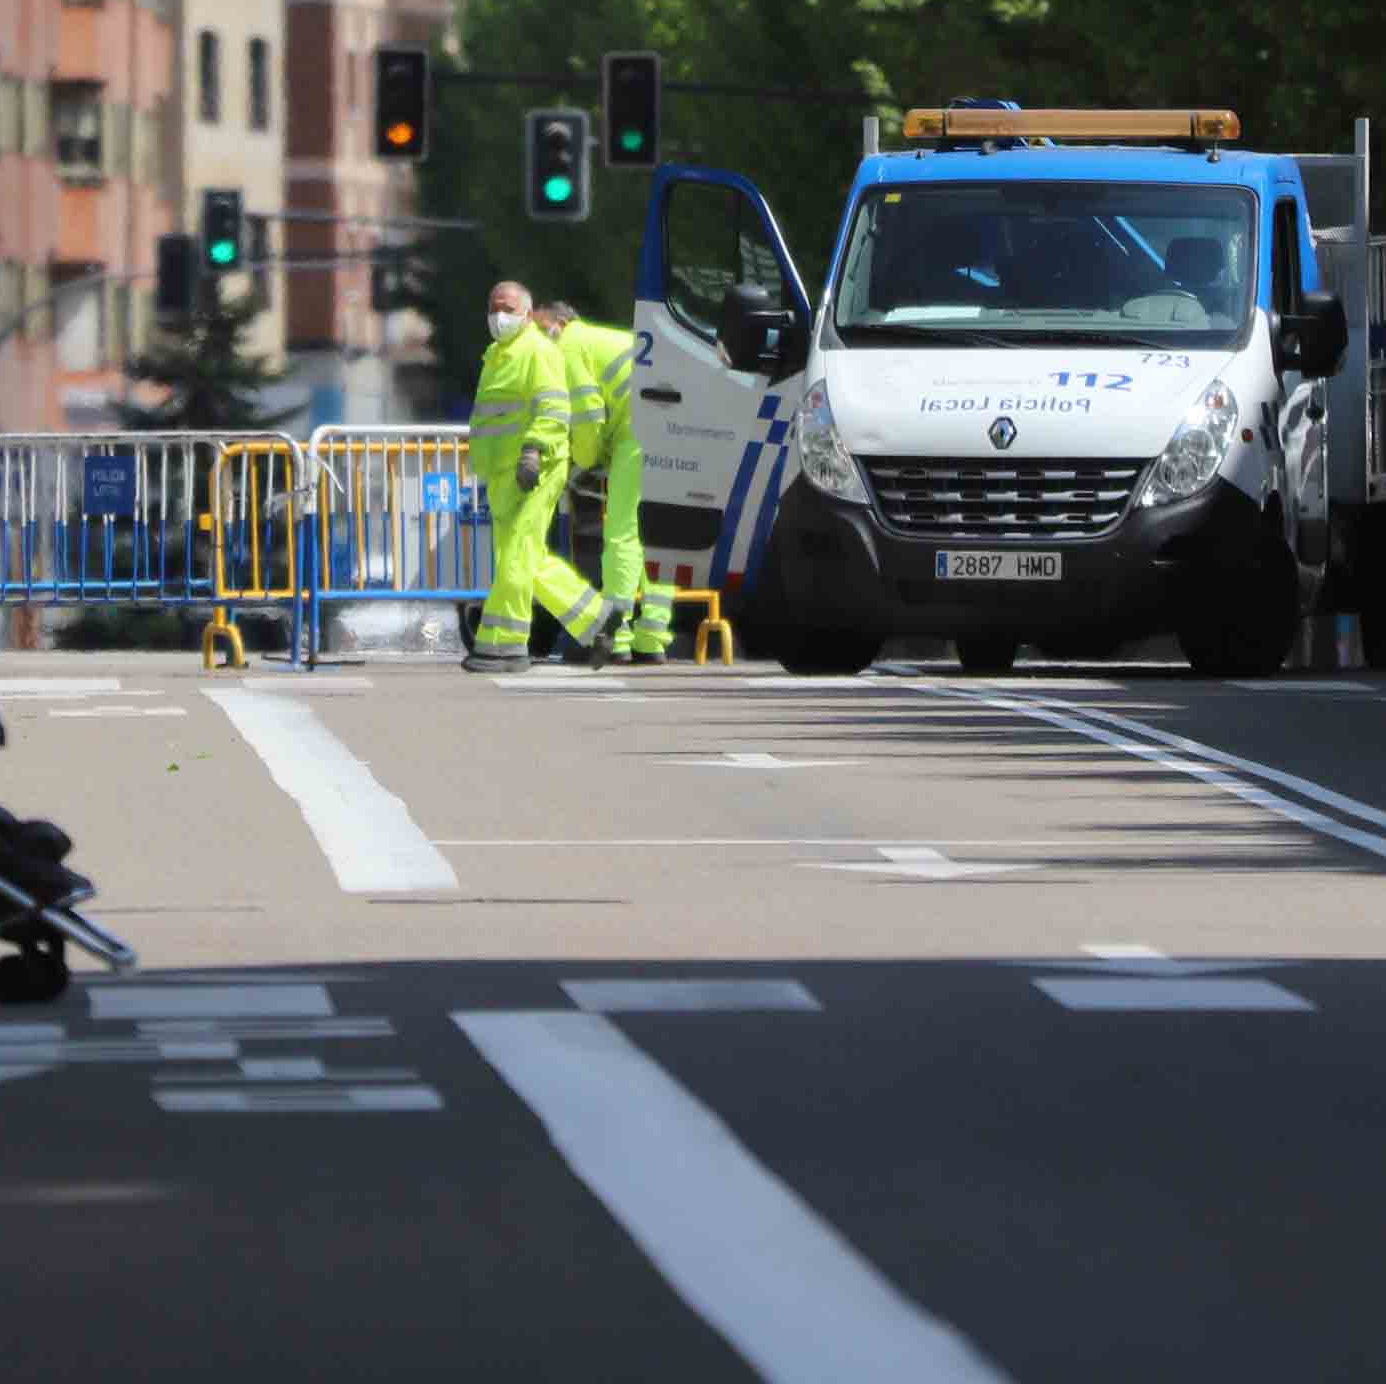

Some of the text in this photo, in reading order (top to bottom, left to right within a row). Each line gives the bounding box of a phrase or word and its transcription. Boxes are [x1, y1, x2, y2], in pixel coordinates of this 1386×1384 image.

[1139, 352, 1190, 369] 723
[1048, 371, 1133, 392] 112
[953, 556, 1056, 577] 2887 HMD
